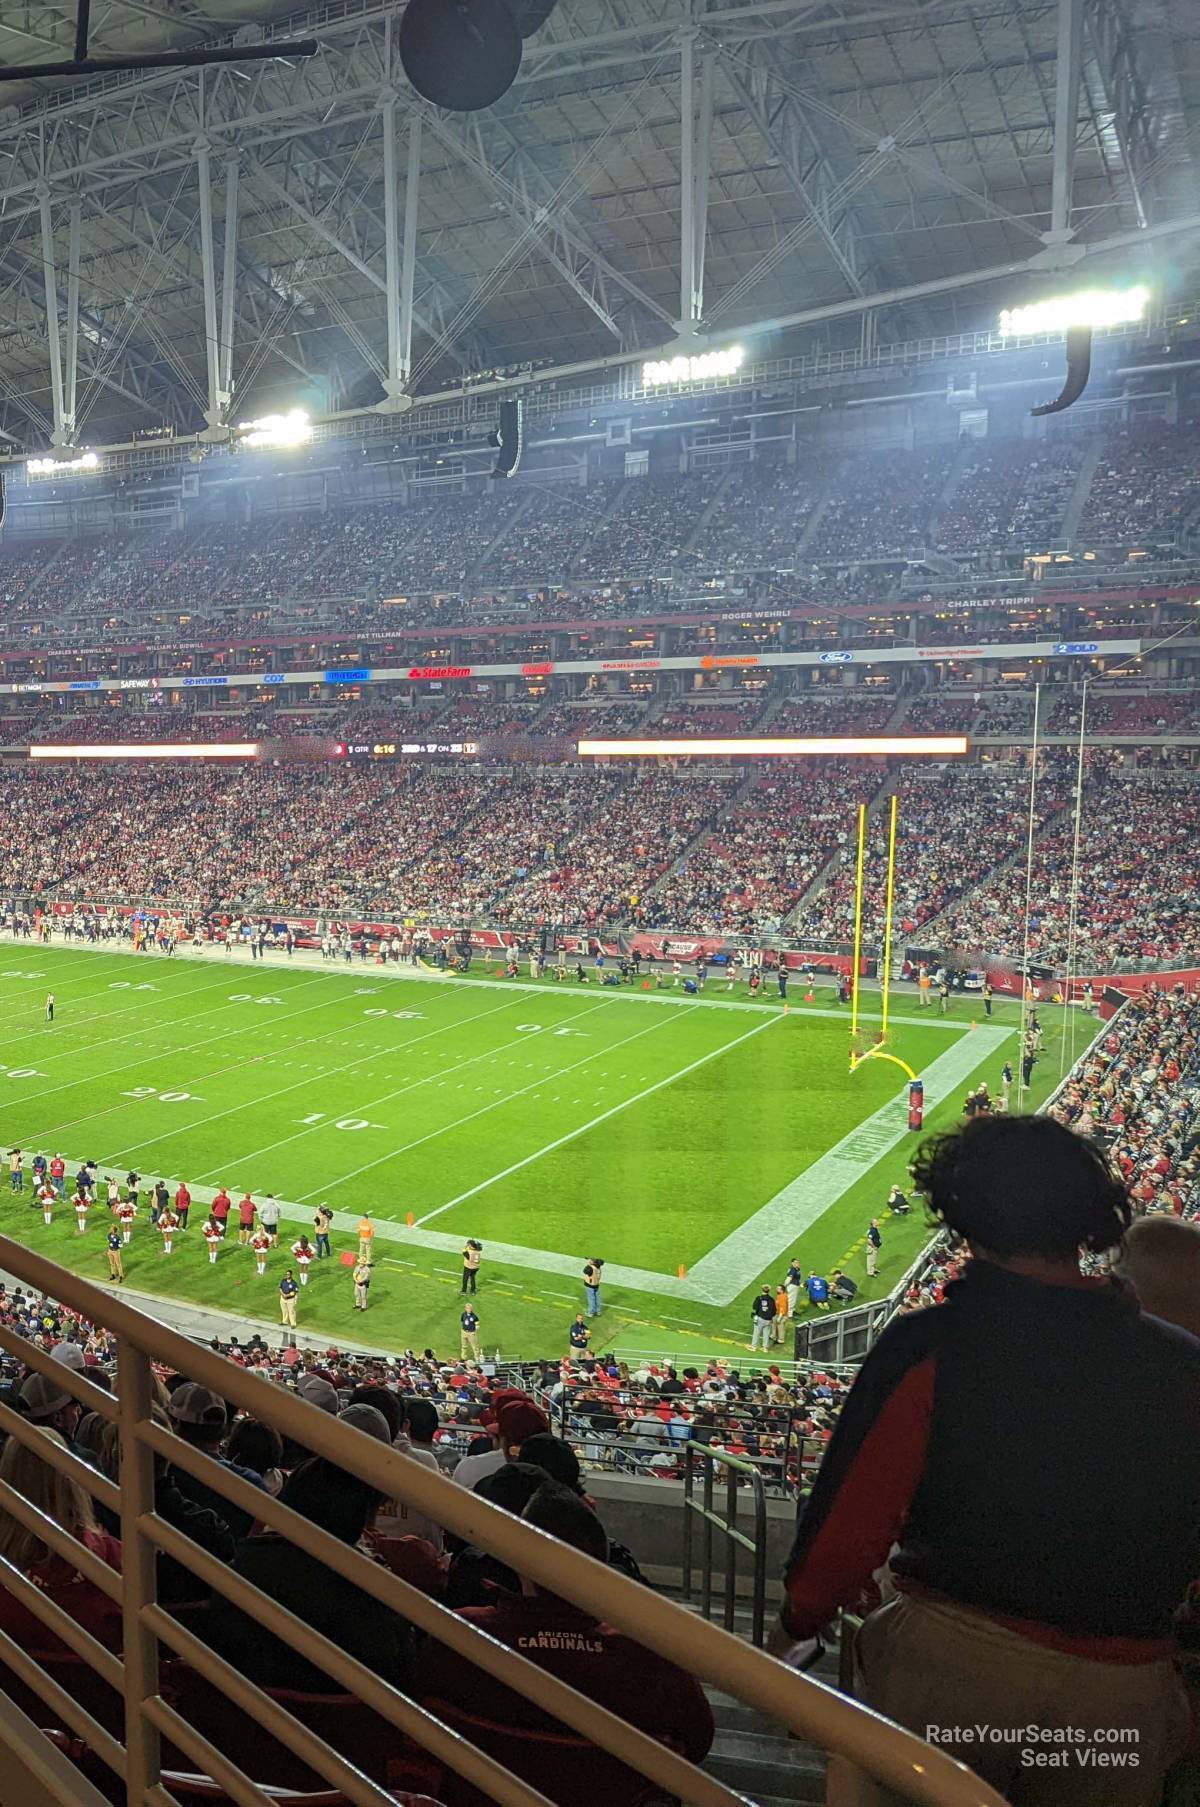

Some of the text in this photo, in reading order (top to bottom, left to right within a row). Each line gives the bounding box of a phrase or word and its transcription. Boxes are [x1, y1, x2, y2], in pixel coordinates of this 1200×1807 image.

[948, 597, 1034, 608] CHARLEY TRIPPI
[722, 610, 791, 620] ROGER WEHRLI
[825, 653, 847, 662] Ford
[264, 674, 285, 682] COX
[120, 680, 150, 688] SAFEWAY
[121, 1087, 191, 1103] 20
[292, 1112, 370, 1131] 10
[537, 1631, 584, 1640] ARIZONA
[518, 1637, 604, 1653] CARDINALS
